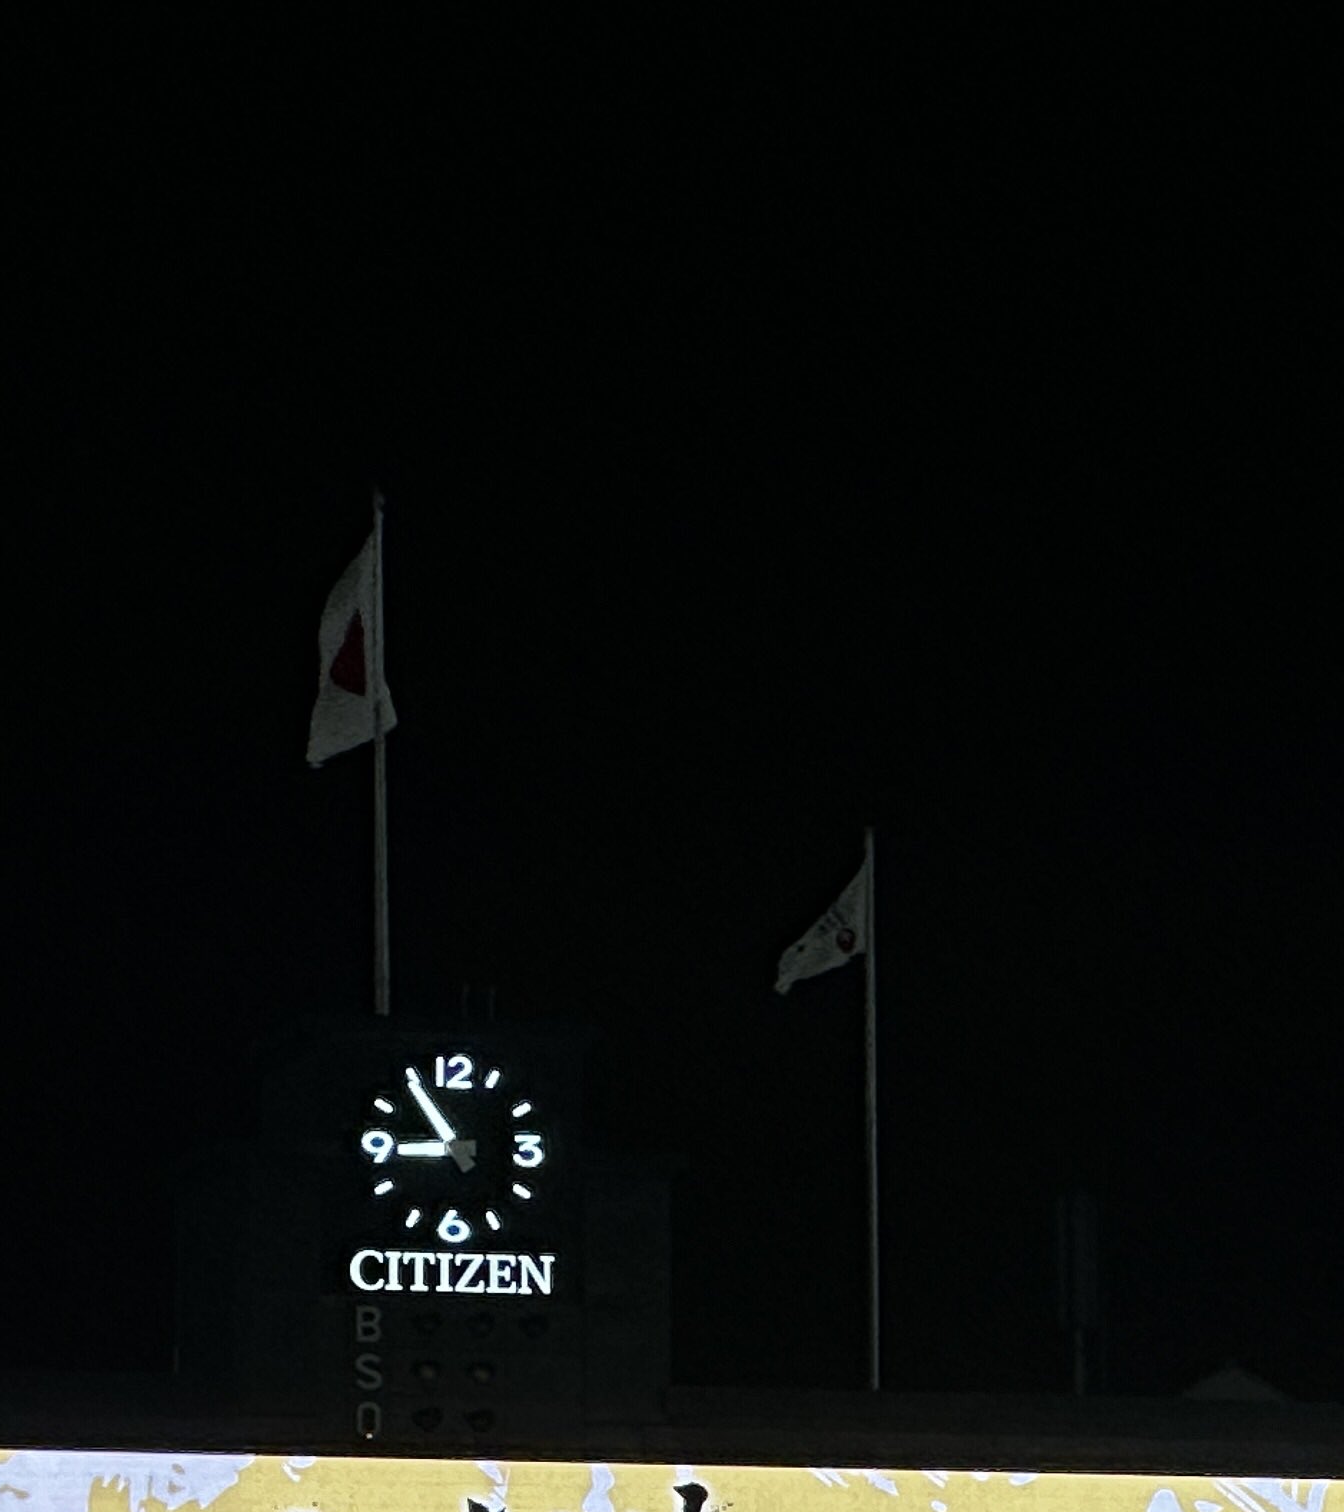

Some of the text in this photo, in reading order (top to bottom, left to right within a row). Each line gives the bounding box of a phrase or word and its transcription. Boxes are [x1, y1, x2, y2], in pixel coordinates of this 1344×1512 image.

[435, 1055, 473, 1089] 12
[361, 1131, 394, 1163] 9
[513, 1134, 544, 1167] 3
[437, 1210, 471, 1242] 6
[350, 1250, 555, 1295] CITIZEN
[356, 1306, 382, 1342] B
[356, 1353, 383, 1391] S
